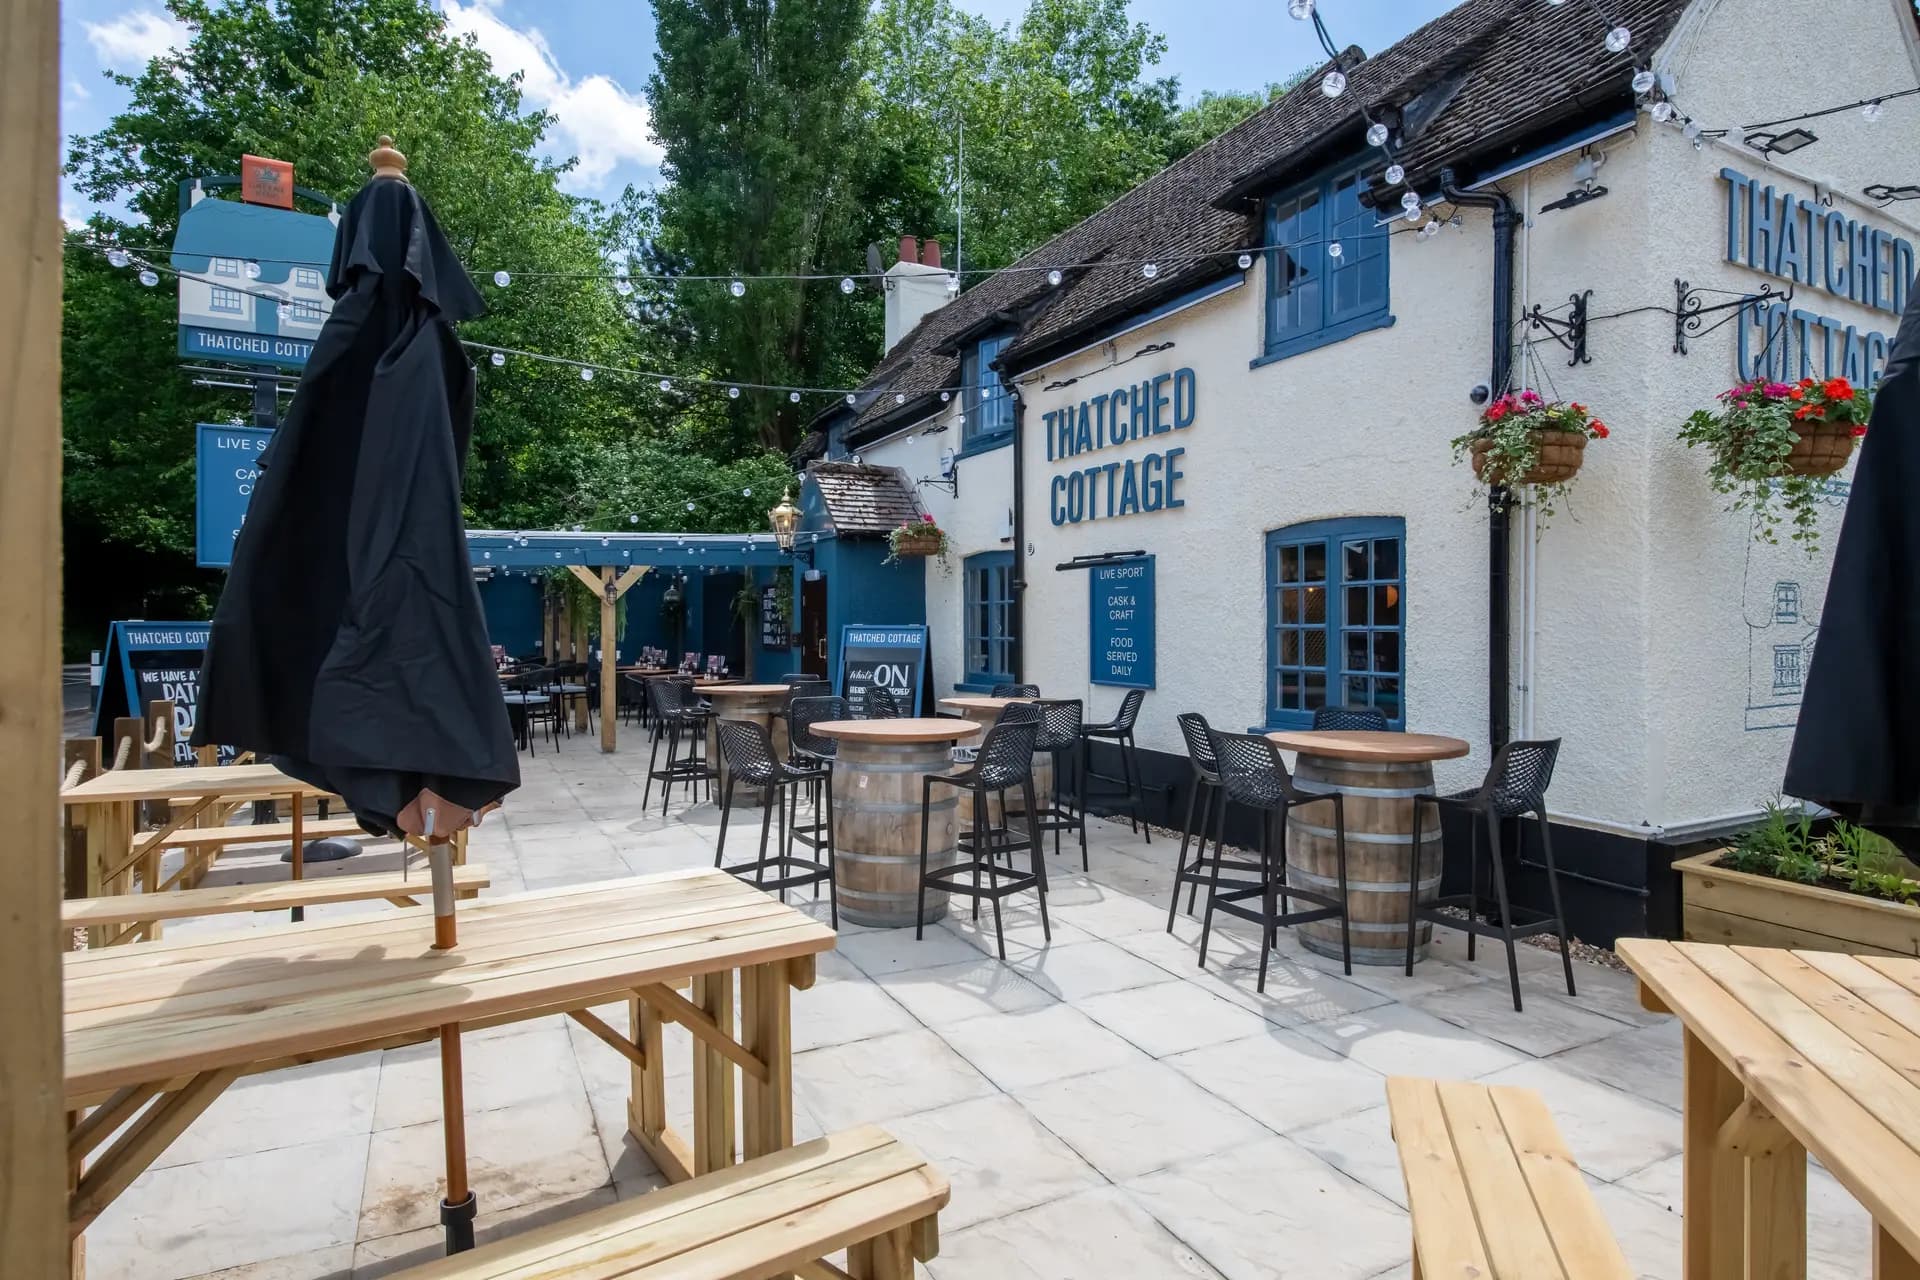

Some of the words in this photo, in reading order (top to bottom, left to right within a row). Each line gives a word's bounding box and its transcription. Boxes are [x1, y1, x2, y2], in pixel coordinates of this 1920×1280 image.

[1719, 167, 1915, 316] THATCHED
[198, 332, 269, 354] THATCHED
[1737, 293, 1897, 396] COTTAG
[1042, 367, 1196, 462] THATCHED
[217, 437, 251, 450] LIVE
[1050, 447, 1186, 526] COTTAGE
[1100, 568, 1116, 580] LIVE
[1117, 567, 1145, 579] SPORT
[1107, 596, 1129, 607] CASK
[1130, 596, 1136, 606] &
[1109, 609, 1134, 620] CRAFT
[127, 632, 182, 644] THATCHED
[849, 632, 886, 644] THATCHED
[887, 633, 921, 644] COTTAGE
[1110, 637, 1133, 648] FOOD
[1106, 651, 1138, 662] SERVED
[142, 671, 159, 683] WE
[160, 670, 188, 682] HAVE
[873, 664, 909, 688] ON
[1111, 665, 1132, 676] DAILY
